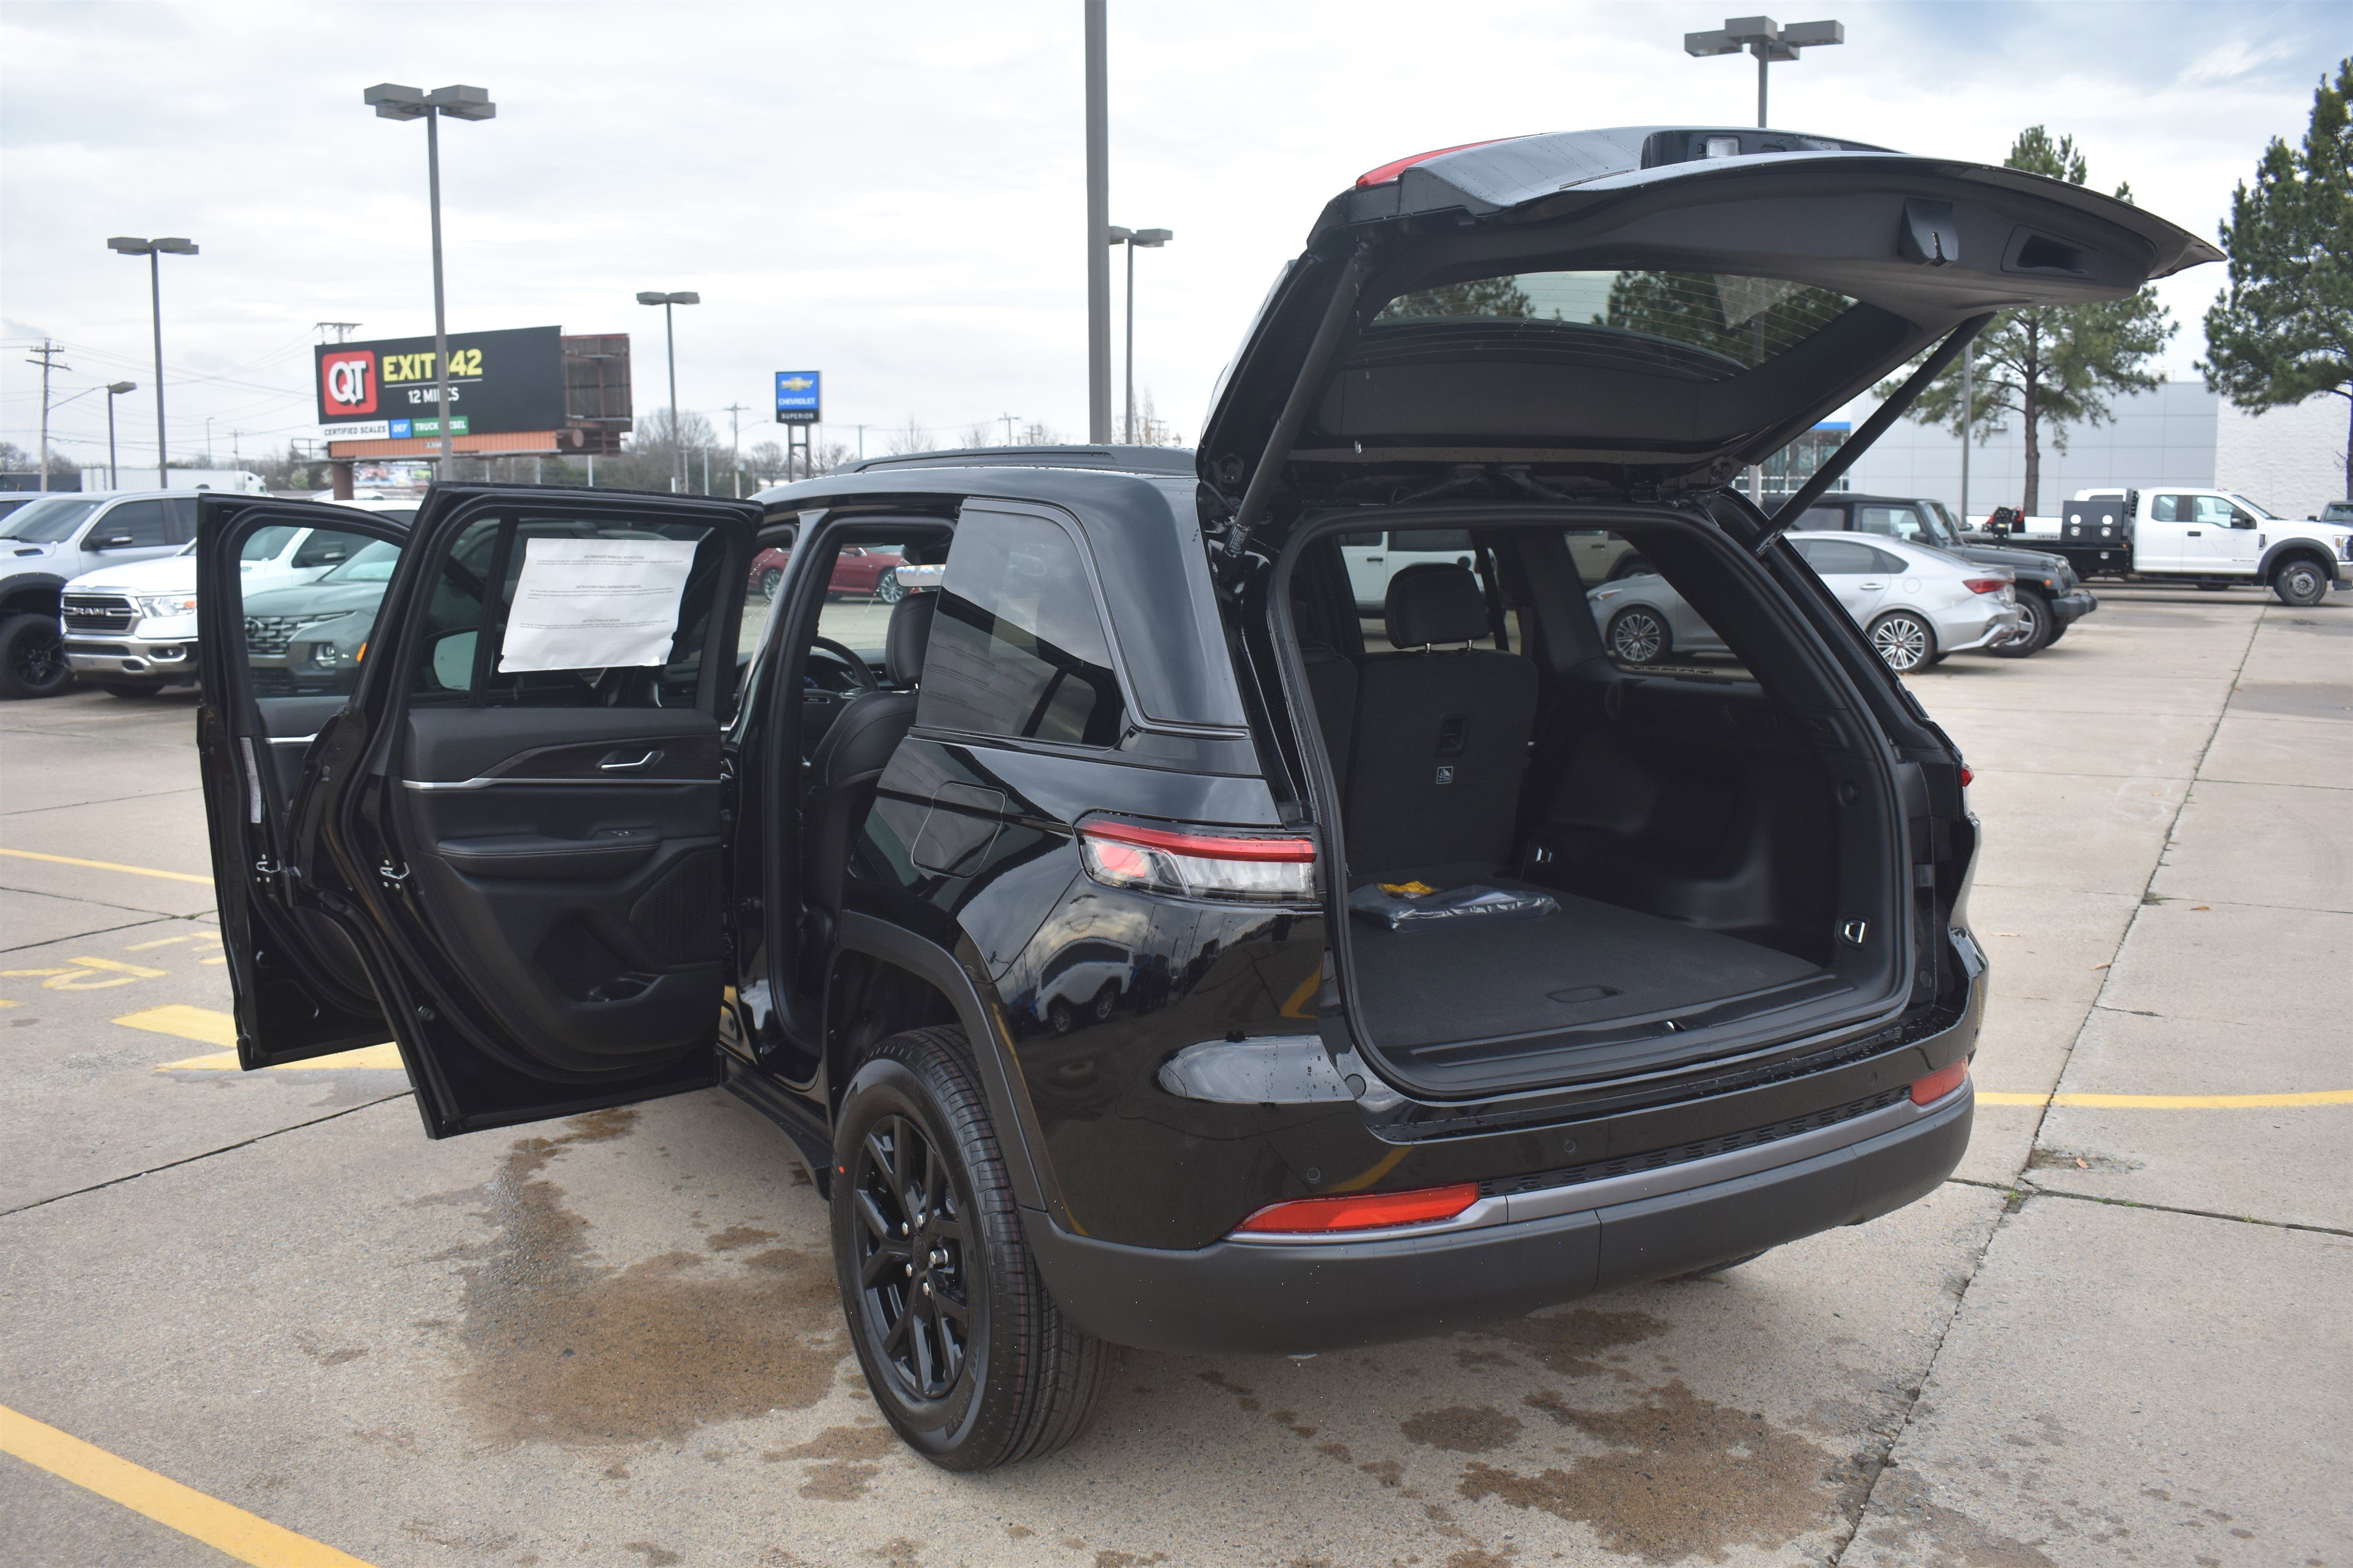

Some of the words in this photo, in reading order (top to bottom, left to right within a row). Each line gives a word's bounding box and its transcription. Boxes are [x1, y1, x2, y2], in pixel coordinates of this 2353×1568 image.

[383, 352, 437, 382] EXIT
[329, 360, 367, 404] QT
[408, 390, 422, 404] 12
[778, 397, 815, 405] CHEVROLET
[325, 427, 359, 436] CERTIFIED
[360, 425, 387, 434] SCALES
[414, 422, 439, 431] TRUCK
[74, 608, 105, 616] RAM
